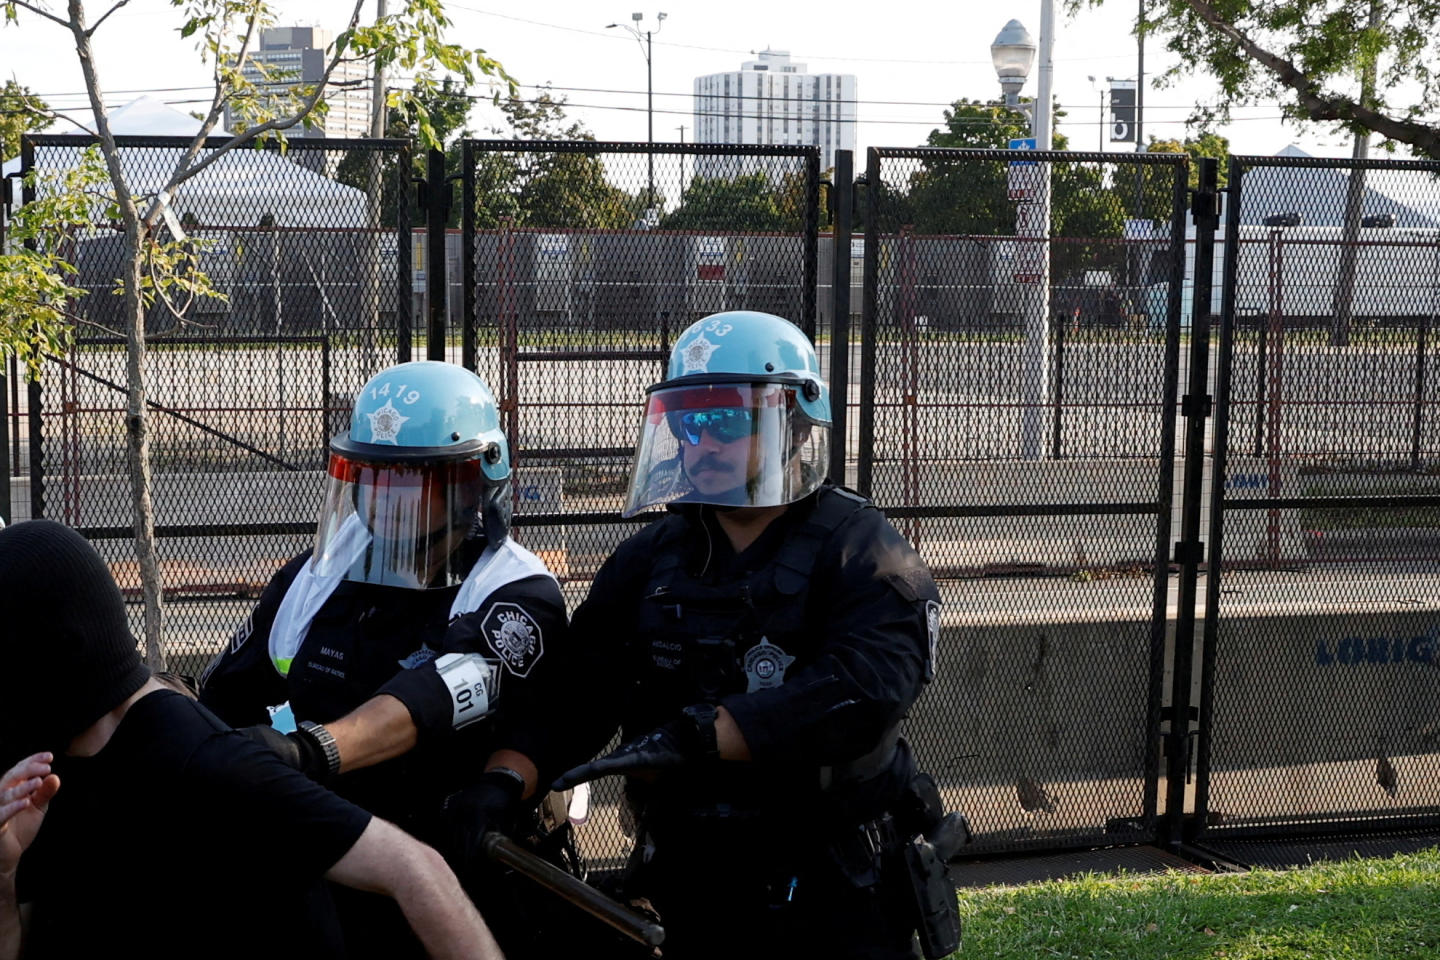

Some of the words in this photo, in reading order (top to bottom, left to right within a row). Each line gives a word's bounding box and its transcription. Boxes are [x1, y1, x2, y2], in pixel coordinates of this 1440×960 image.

[370, 382, 420, 405] 1419
[497, 611, 536, 655] CHICAGO
[320, 645, 344, 660] MAYAS
[492, 629, 524, 667] POLICE
[453, 678, 474, 714] 101
[474, 682, 484, 697] CG
